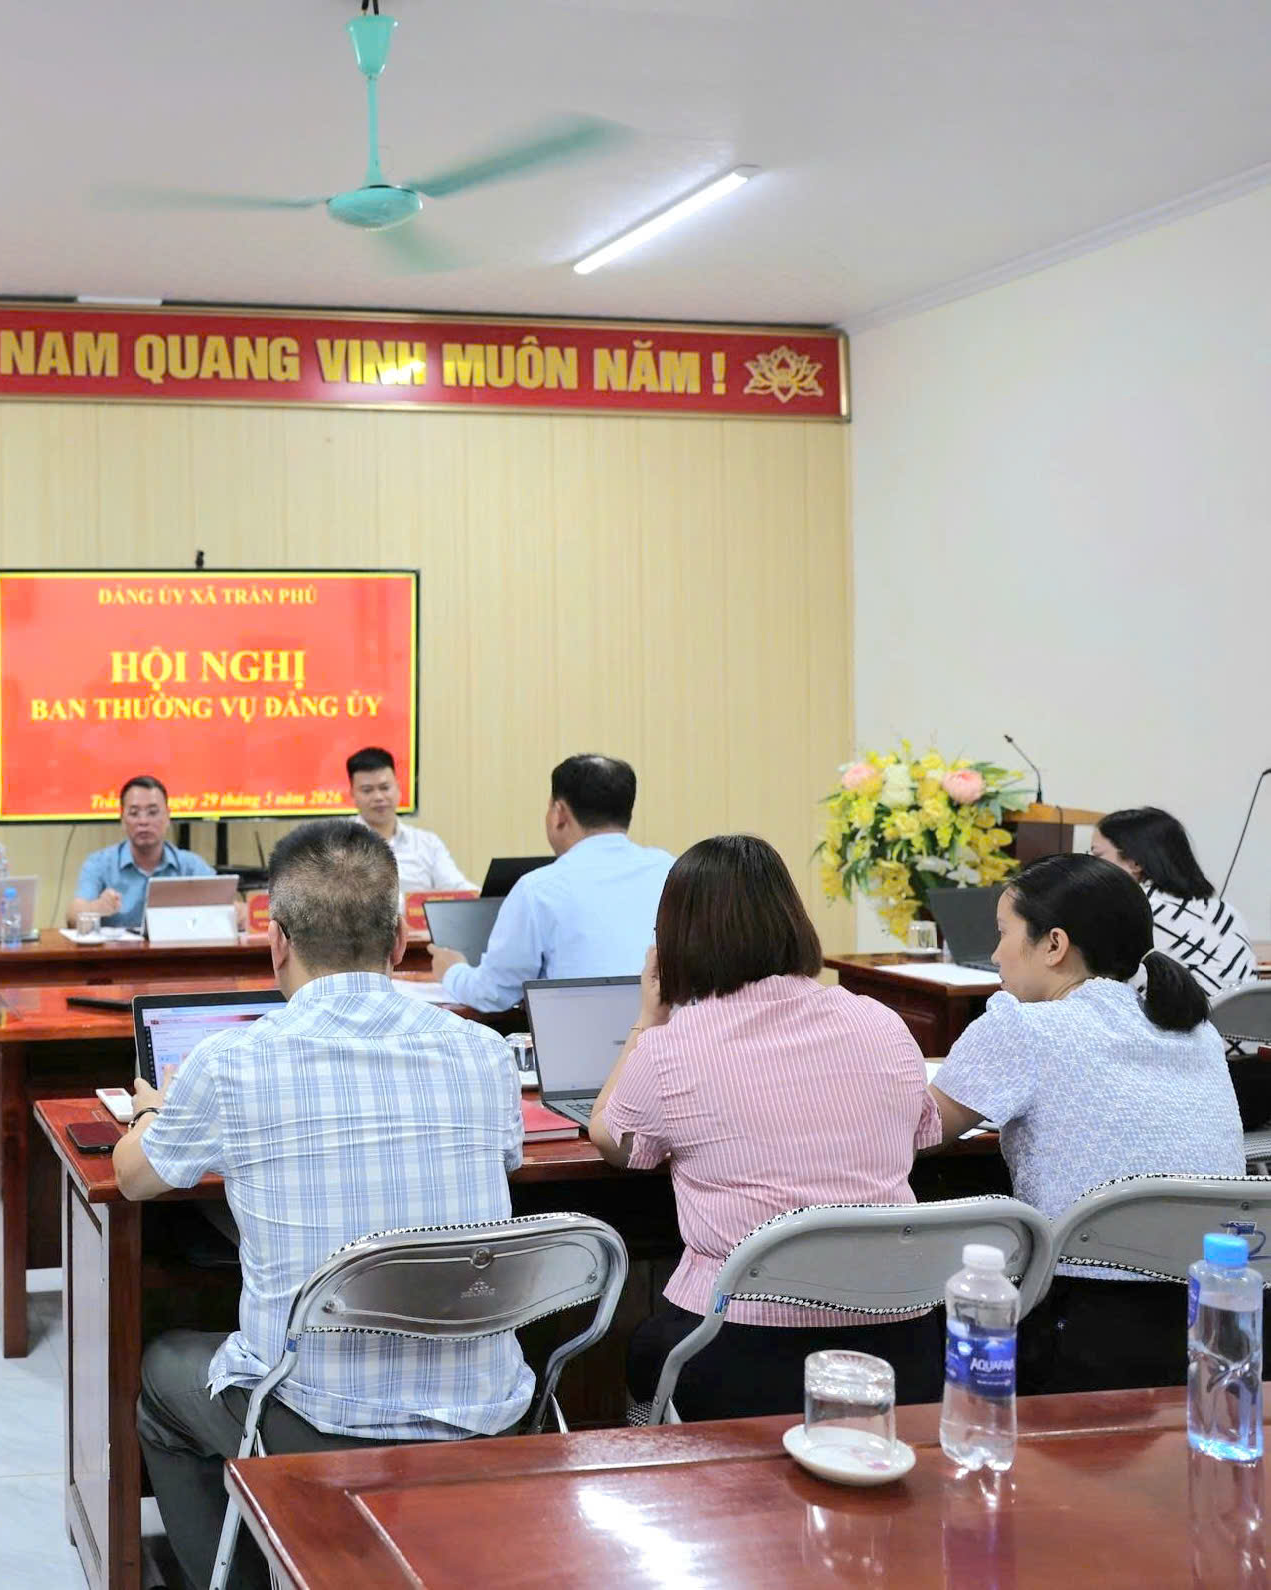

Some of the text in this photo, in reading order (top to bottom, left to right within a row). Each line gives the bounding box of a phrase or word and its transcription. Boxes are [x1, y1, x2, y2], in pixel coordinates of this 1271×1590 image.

[0, 331, 119, 377] NAM
[134, 335, 302, 385] QUANG
[316, 338, 427, 386] VINH
[442, 336, 576, 391] MUÔN
[593, 340, 701, 395] NĂM
[711, 352, 727, 396] !
[98, 585, 154, 605] ĐẢNG
[159, 584, 186, 605] ỦY
[190, 584, 218, 605] XÃ
[222, 584, 274, 605] TRẦN
[110, 646, 307, 691] HỘI NGHỊ
[31, 689, 382, 723] BAN THƯỜNG VỤ ĐẢNG ỦY
[221, 791, 261, 810] tháng
[275, 791, 306, 806] năm
